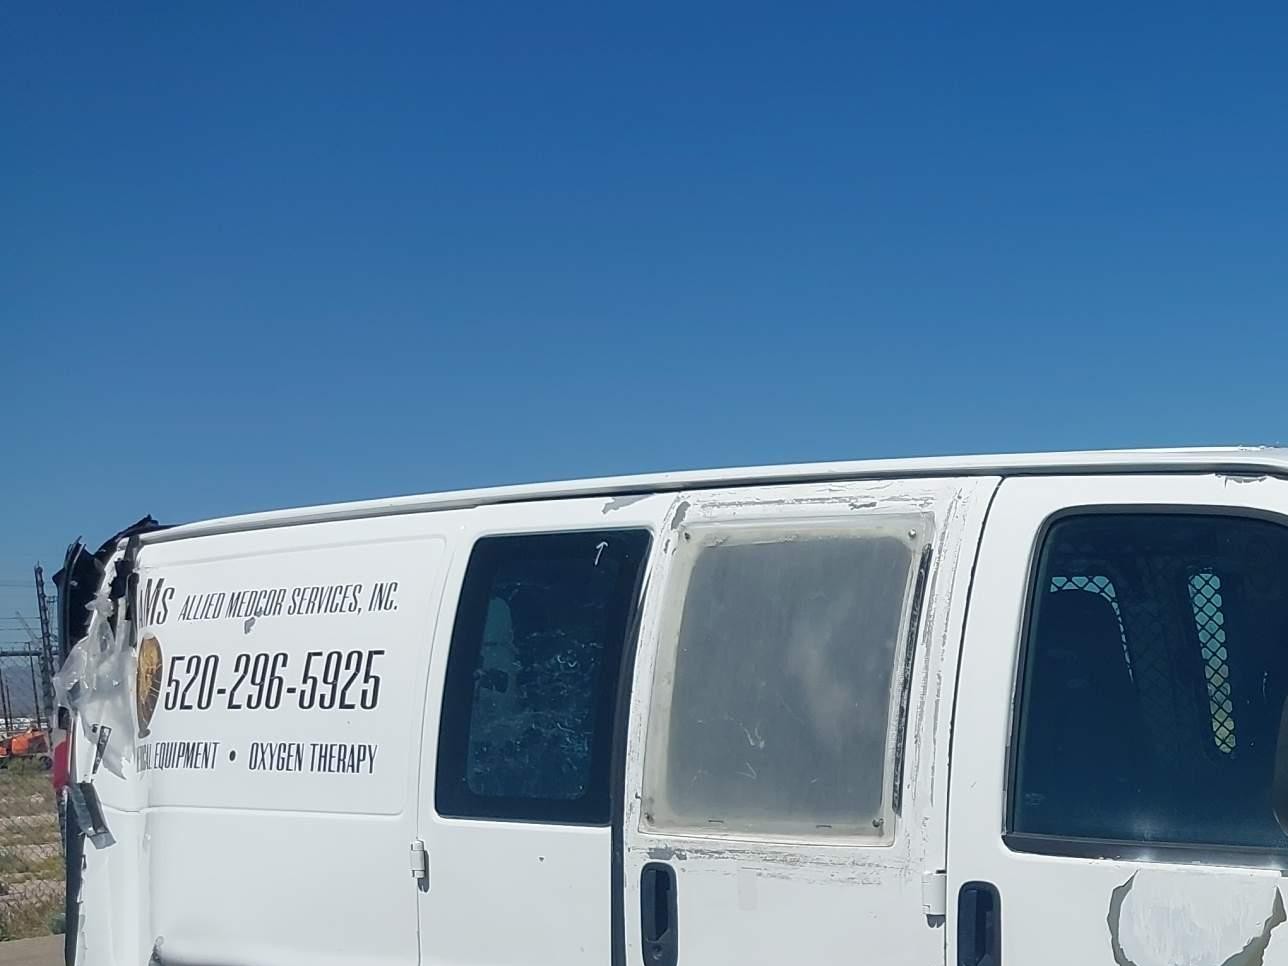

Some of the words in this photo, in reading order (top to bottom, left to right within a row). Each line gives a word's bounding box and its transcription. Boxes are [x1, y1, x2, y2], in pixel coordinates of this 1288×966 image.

[177, 592, 226, 621] ALLIED
[225, 588, 287, 618] MEDCOR
[287, 583, 362, 616] SERVICES,
[367, 581, 398, 612] INC.
[164, 649, 385, 710] 520-296-5925
[154, 741, 220, 770] EQUIPMENT
[248, 742, 305, 772] OXYGEN
[310, 743, 378, 774] THERAPY
